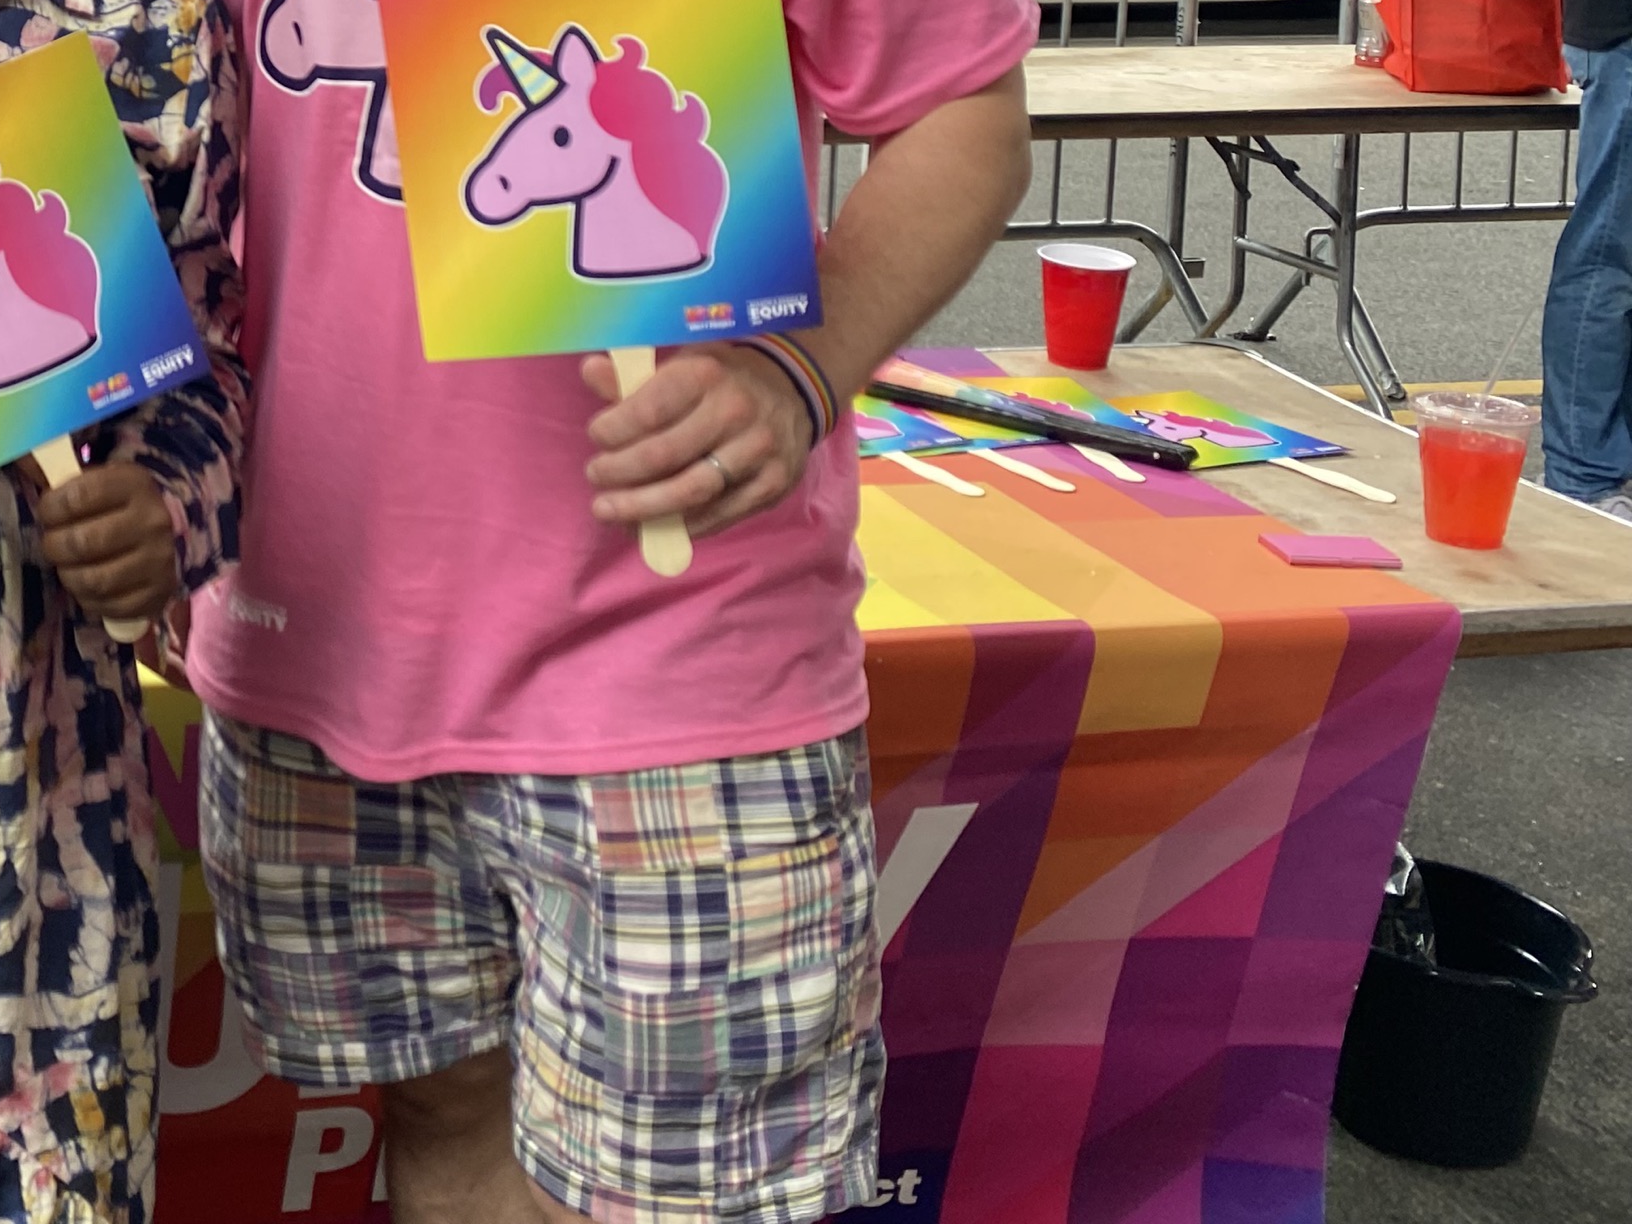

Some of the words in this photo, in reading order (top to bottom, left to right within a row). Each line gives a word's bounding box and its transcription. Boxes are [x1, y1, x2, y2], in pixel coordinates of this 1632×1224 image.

[1176, 6, 1185, 43] SONC
[748, 300, 809, 321] EQUITY
[141, 346, 194, 380] EQUITY
